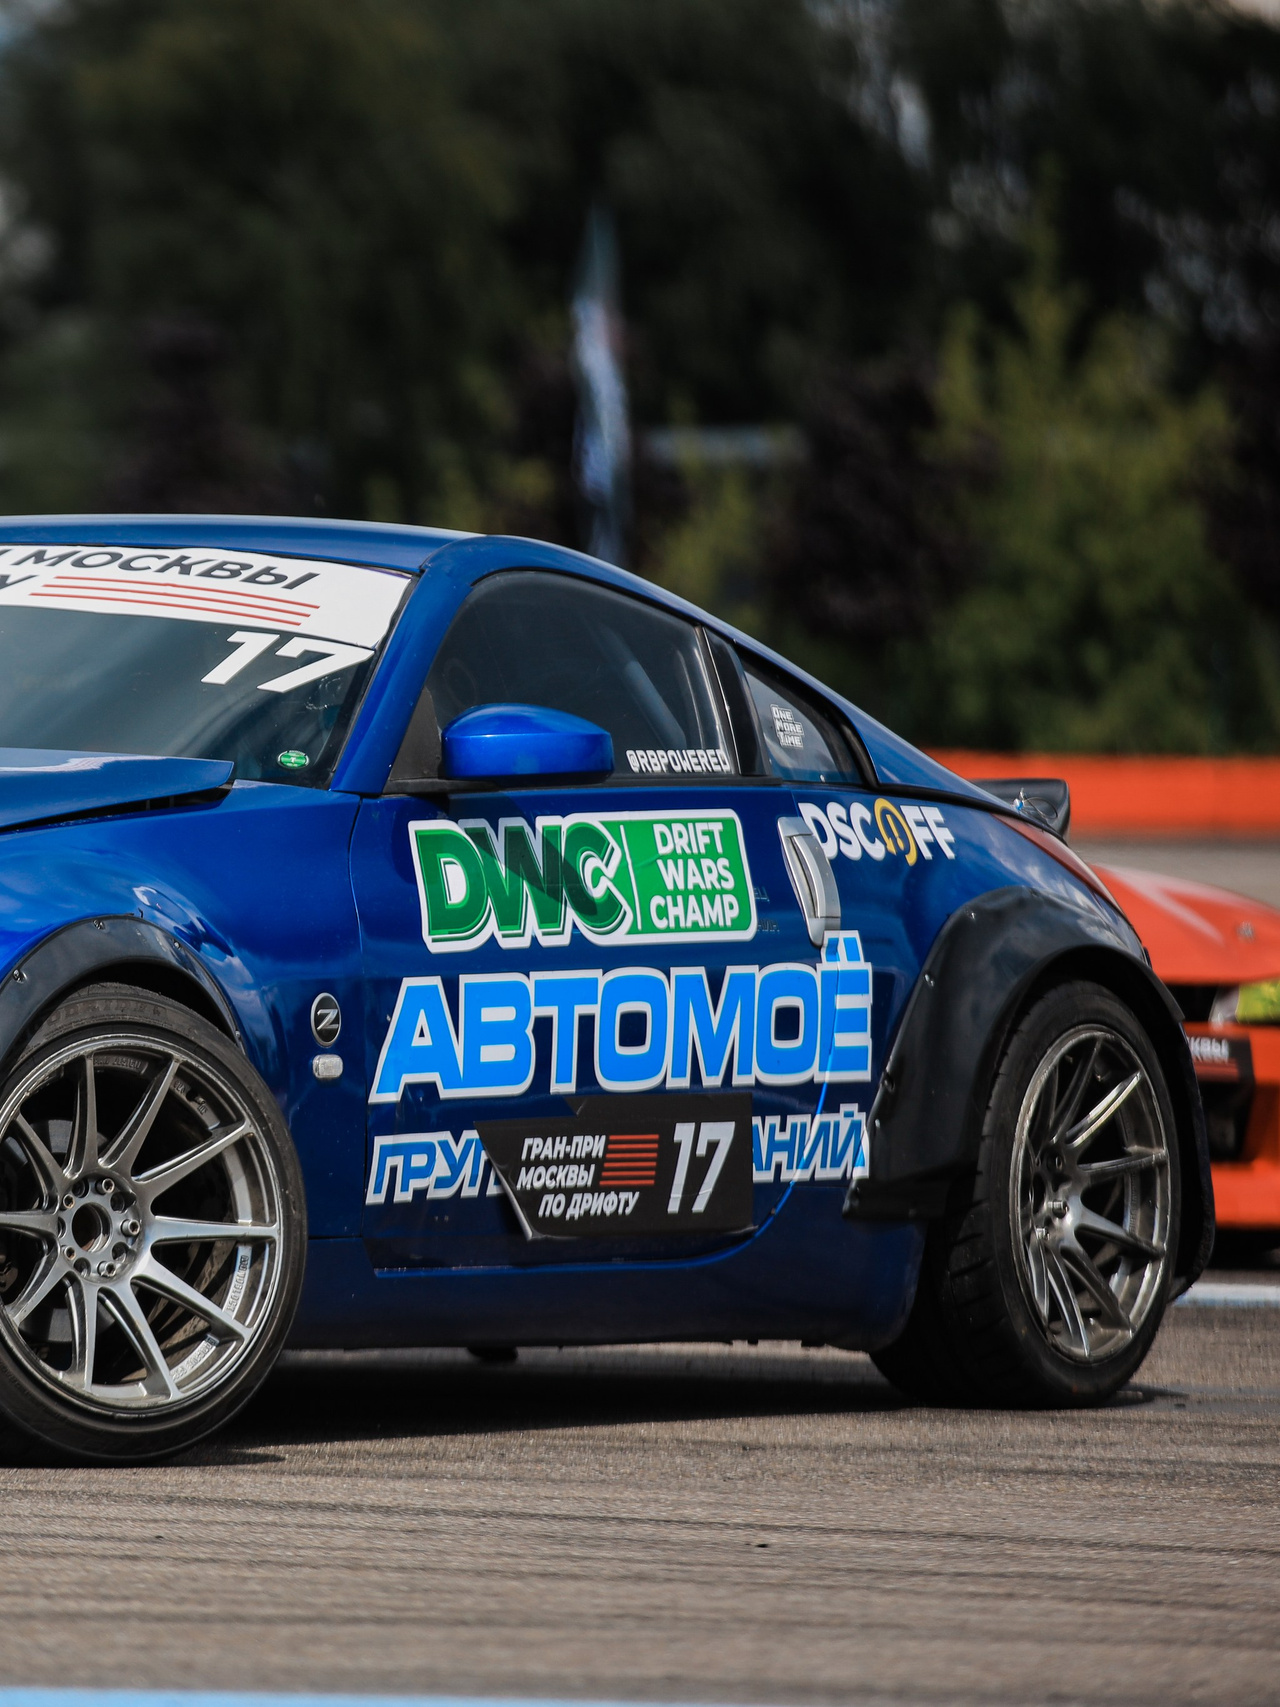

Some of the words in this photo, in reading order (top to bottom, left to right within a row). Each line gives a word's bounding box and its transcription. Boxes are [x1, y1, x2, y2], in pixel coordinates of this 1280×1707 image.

[11, 549, 320, 590] МОСКВЫ
[200, 630, 375, 694] 17
[625, 749, 731, 773] @RBPOWERED
[653, 821, 724, 855] DRIFT
[409, 816, 632, 953] DWC
[657, 857, 735, 891] WARS
[649, 895, 740, 930] CHAMP
[368, 930, 873, 1103] АВТОМОЁ
[521, 1134, 607, 1161] ГРАН-ПРИ
[516, 1163, 596, 1191] МОСКВЫ
[667, 1121, 736, 1214] 17
[538, 1193, 566, 1218] ПО
[565, 1191, 640, 1221] ДРИФТУ
